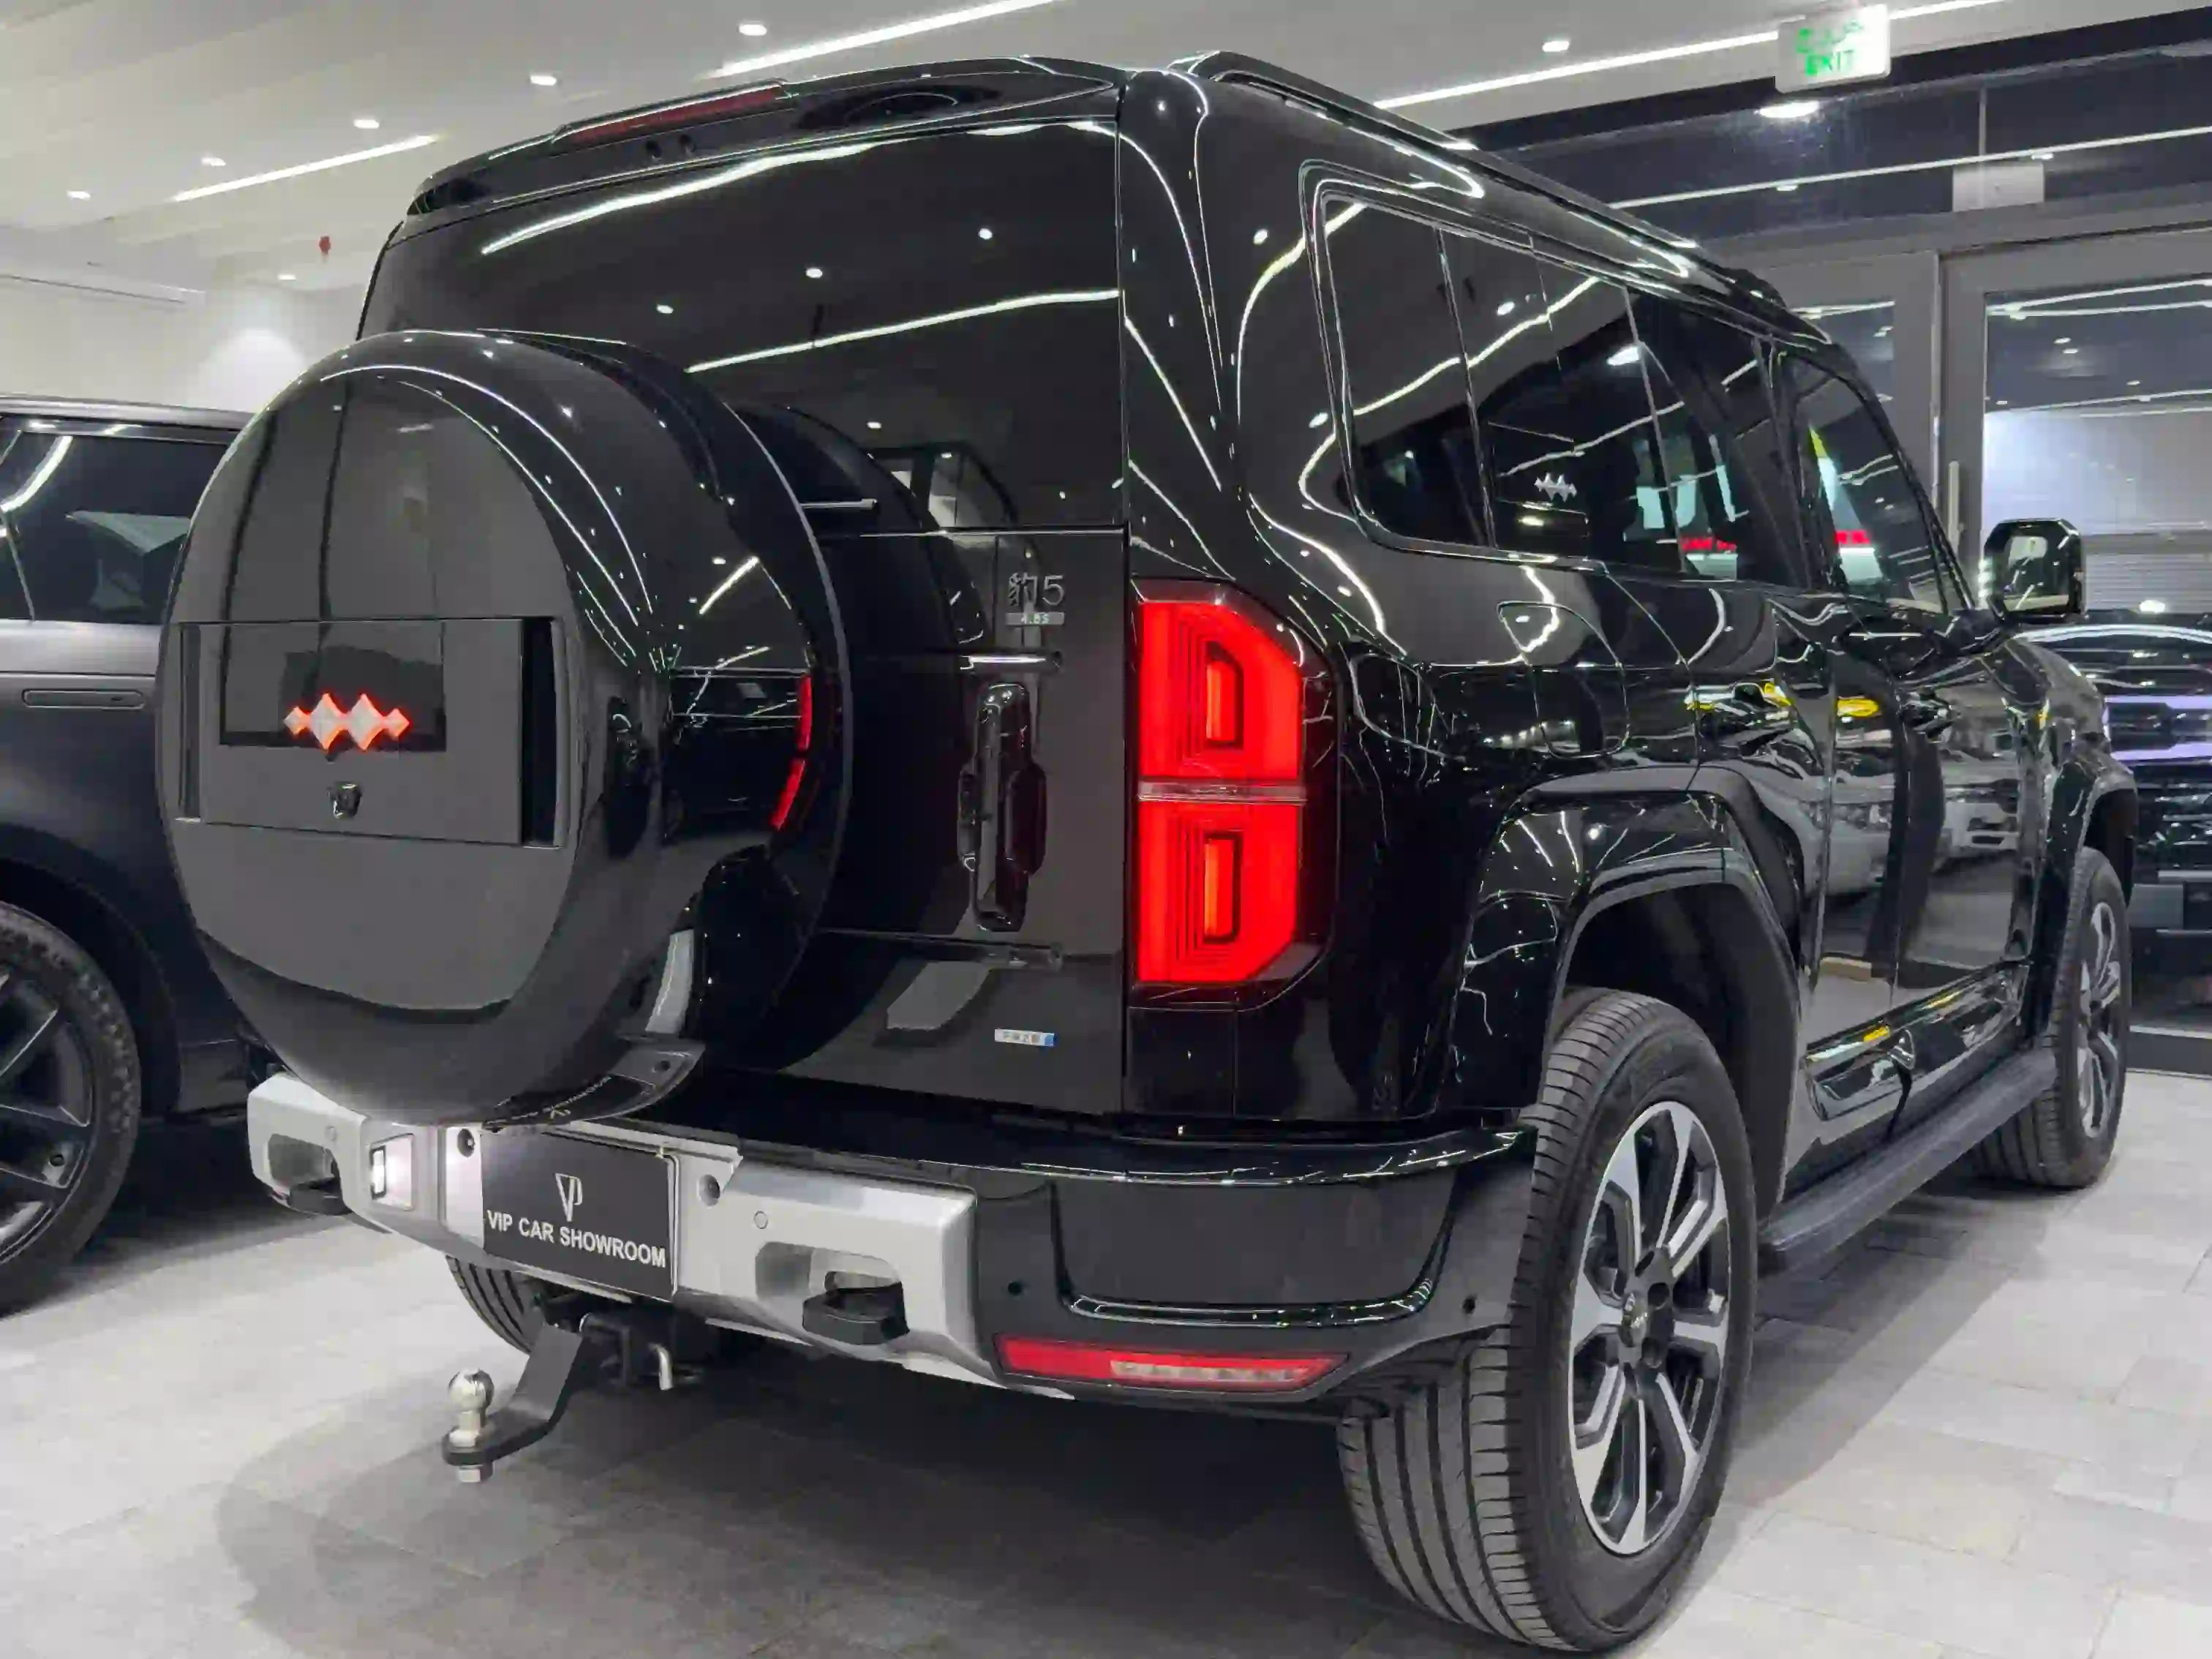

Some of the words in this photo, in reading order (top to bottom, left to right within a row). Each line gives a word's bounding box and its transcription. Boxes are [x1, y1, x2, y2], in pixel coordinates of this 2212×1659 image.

[1805, 50, 1855, 76] EXIT
[487, 1209, 513, 1232] VIP
[519, 1217, 554, 1243] CAR
[560, 1226, 666, 1268] SHOWROOM
